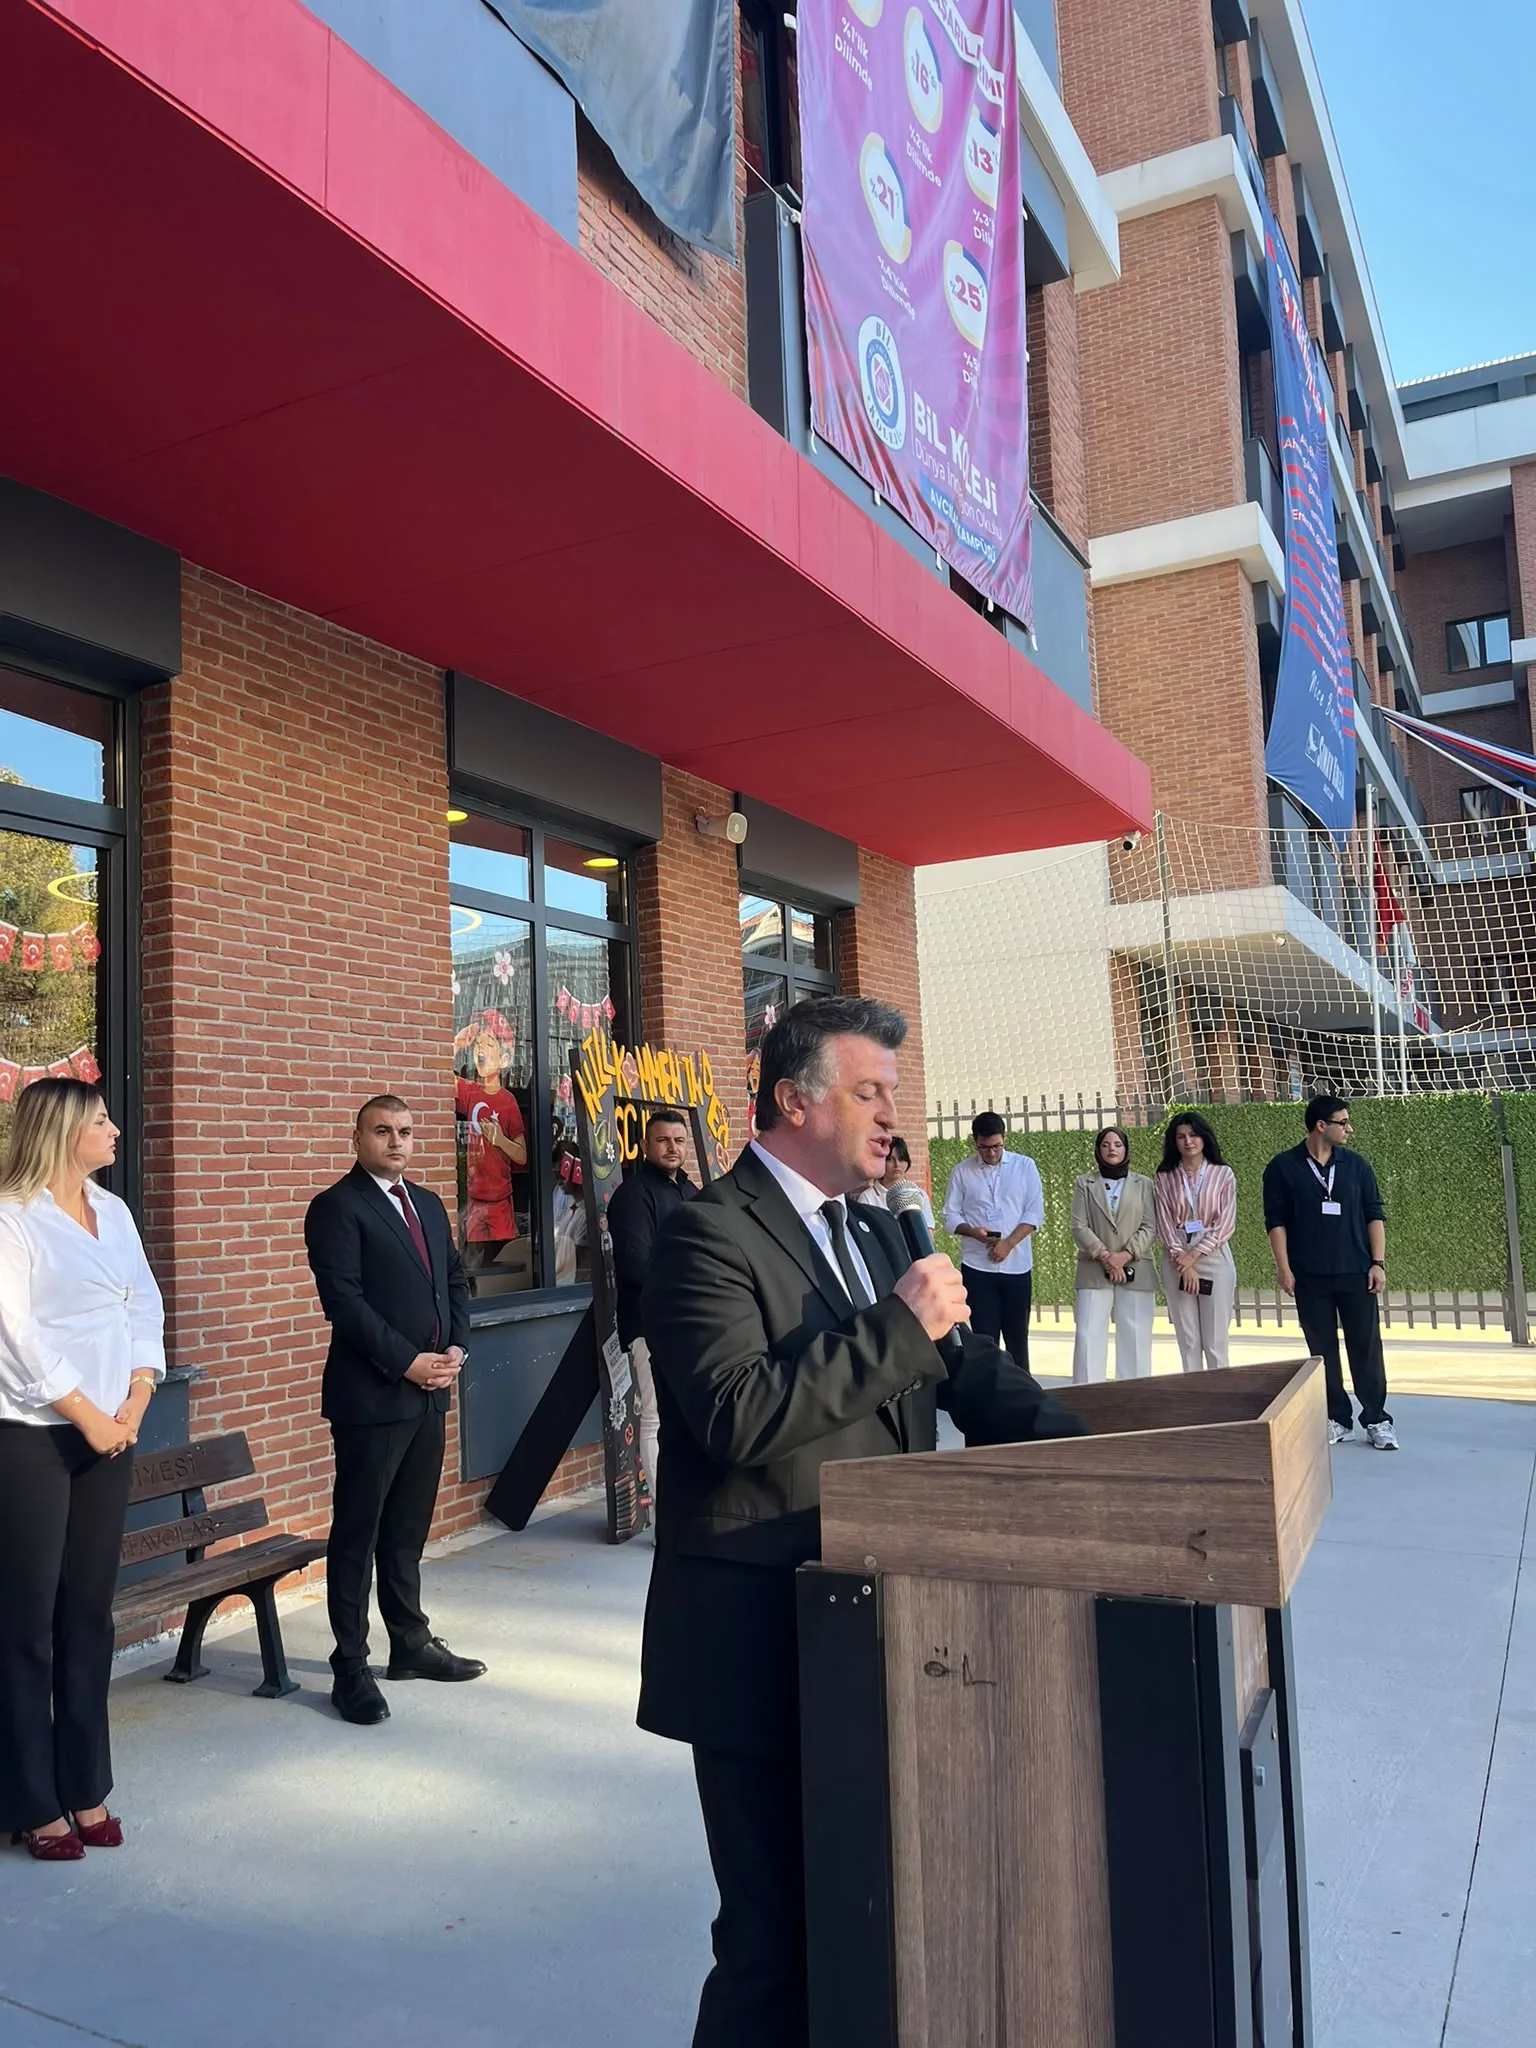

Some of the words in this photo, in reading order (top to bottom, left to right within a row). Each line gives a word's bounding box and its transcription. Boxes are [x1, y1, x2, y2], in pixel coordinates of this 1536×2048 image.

[834, 33, 873, 92] Dilimde
[906, 141, 943, 188] Dilimde
[914, 391, 946, 455] BİL
[915, 437, 945, 483] Dünya
